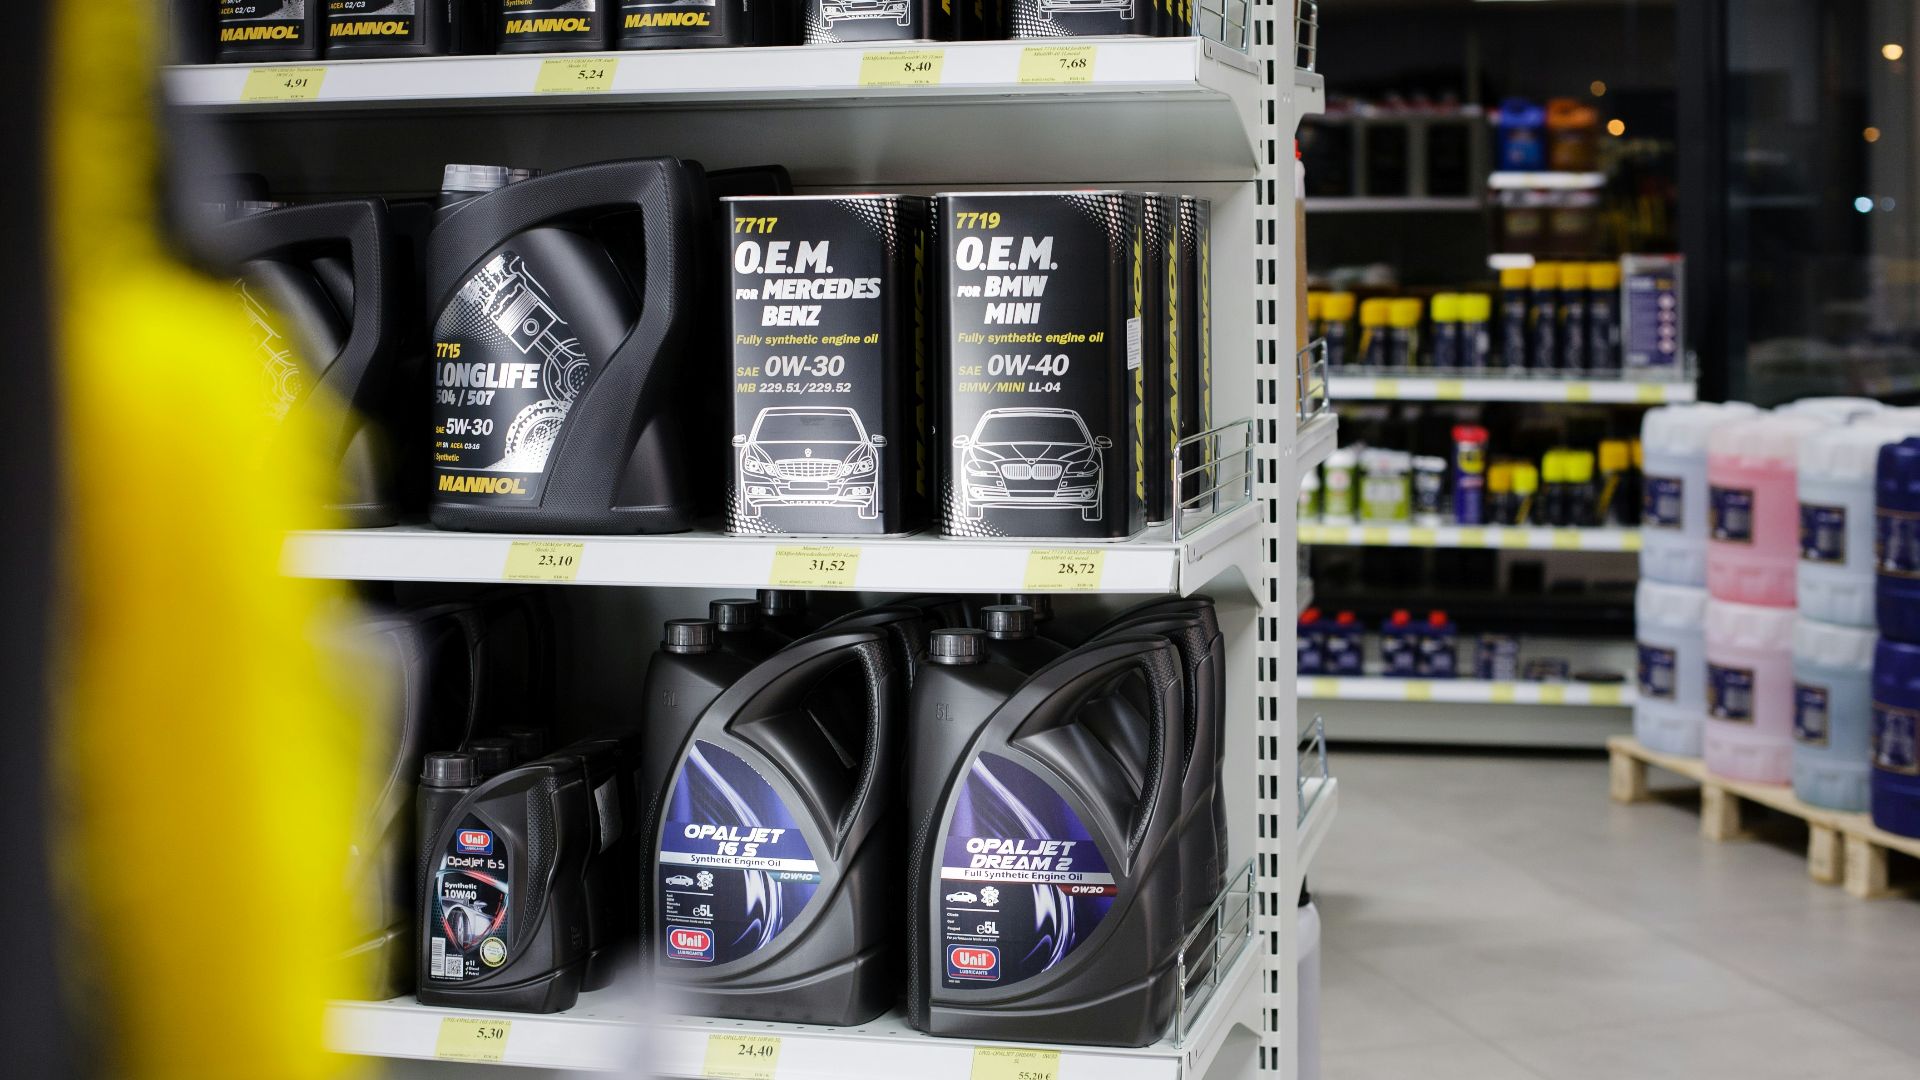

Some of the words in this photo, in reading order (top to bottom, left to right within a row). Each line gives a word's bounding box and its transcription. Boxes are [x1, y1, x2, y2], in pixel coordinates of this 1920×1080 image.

[506, 18, 590, 34] MANNOL
[625, 13, 709, 28] MANNOL
[221, 26, 298, 41] MANNOL
[330, 22, 408, 36] MANNOL
[904, 62, 931, 73] 8,40
[578, 70, 604, 81] 5,24
[735, 218, 777, 233] 7717
[956, 212, 1000, 229] 7719
[735, 240, 833, 274] O.E.M.
[956, 236, 1058, 271] O.E.M.
[736, 289, 758, 300] FOR
[762, 278, 881, 300] MERCEDES
[957, 286, 981, 298] FOR
[984, 275, 1048, 297] BMW
[762, 305, 821, 326] BENZ
[984, 303, 1041, 324] MINI
[736, 334, 762, 346] Fully
[765, 334, 817, 346] synthetic
[822, 334, 860, 346] engine
[864, 334, 878, 344] oil
[958, 333, 985, 345] Fully
[988, 333, 1042, 345] synthetic
[1046, 333, 1085, 344] engine
[1089, 332, 1104, 343] oil
[436, 343, 461, 358] 7715
[737, 367, 759, 376] SAE
[765, 356, 845, 377] 0W-30
[958, 366, 982, 376] SAE
[987, 354, 1069, 376] 0W-40
[436, 362, 541, 388] LONGLIFE
[737, 383, 756, 392] MB
[759, 383, 851, 394] 229.51/229.52
[958, 382, 1025, 393] BMW/MINI
[1028, 382, 1061, 393] LL-04
[436, 390, 456, 405] 504
[467, 390, 495, 406] 507
[436, 426, 445, 434] SAE
[445, 418, 493, 436] 5W-30
[436, 453, 460, 462] Synthetic
[438, 474, 526, 495] MANNOL
[809, 560, 845, 572] 31,52
[1058, 563, 1095, 575] 28,72
[466, 834, 484, 844] Unil
[684, 824, 786, 843] OPALJET
[717, 842, 738, 856] 16
[742, 843, 759, 857] S
[966, 838, 1077, 856] OPALJET
[498, 860, 505, 869] S
[691, 854, 732, 864] Synthetic
[735, 856, 765, 866] Engine
[970, 855, 1052, 870] DREAM
[1056, 858, 1073, 871] 2
[984, 870, 1029, 880] Synthetic
[1032, 872, 1065, 882] Engine
[445, 890, 477, 900] 10W40
[678, 933, 702, 947] Unil
[960, 952, 987, 966] Unil
[477, 1028, 504, 1040] 5,30
[738, 1044, 773, 1058] 24,40
[1018, 1071, 1043, 1080] 55,20
